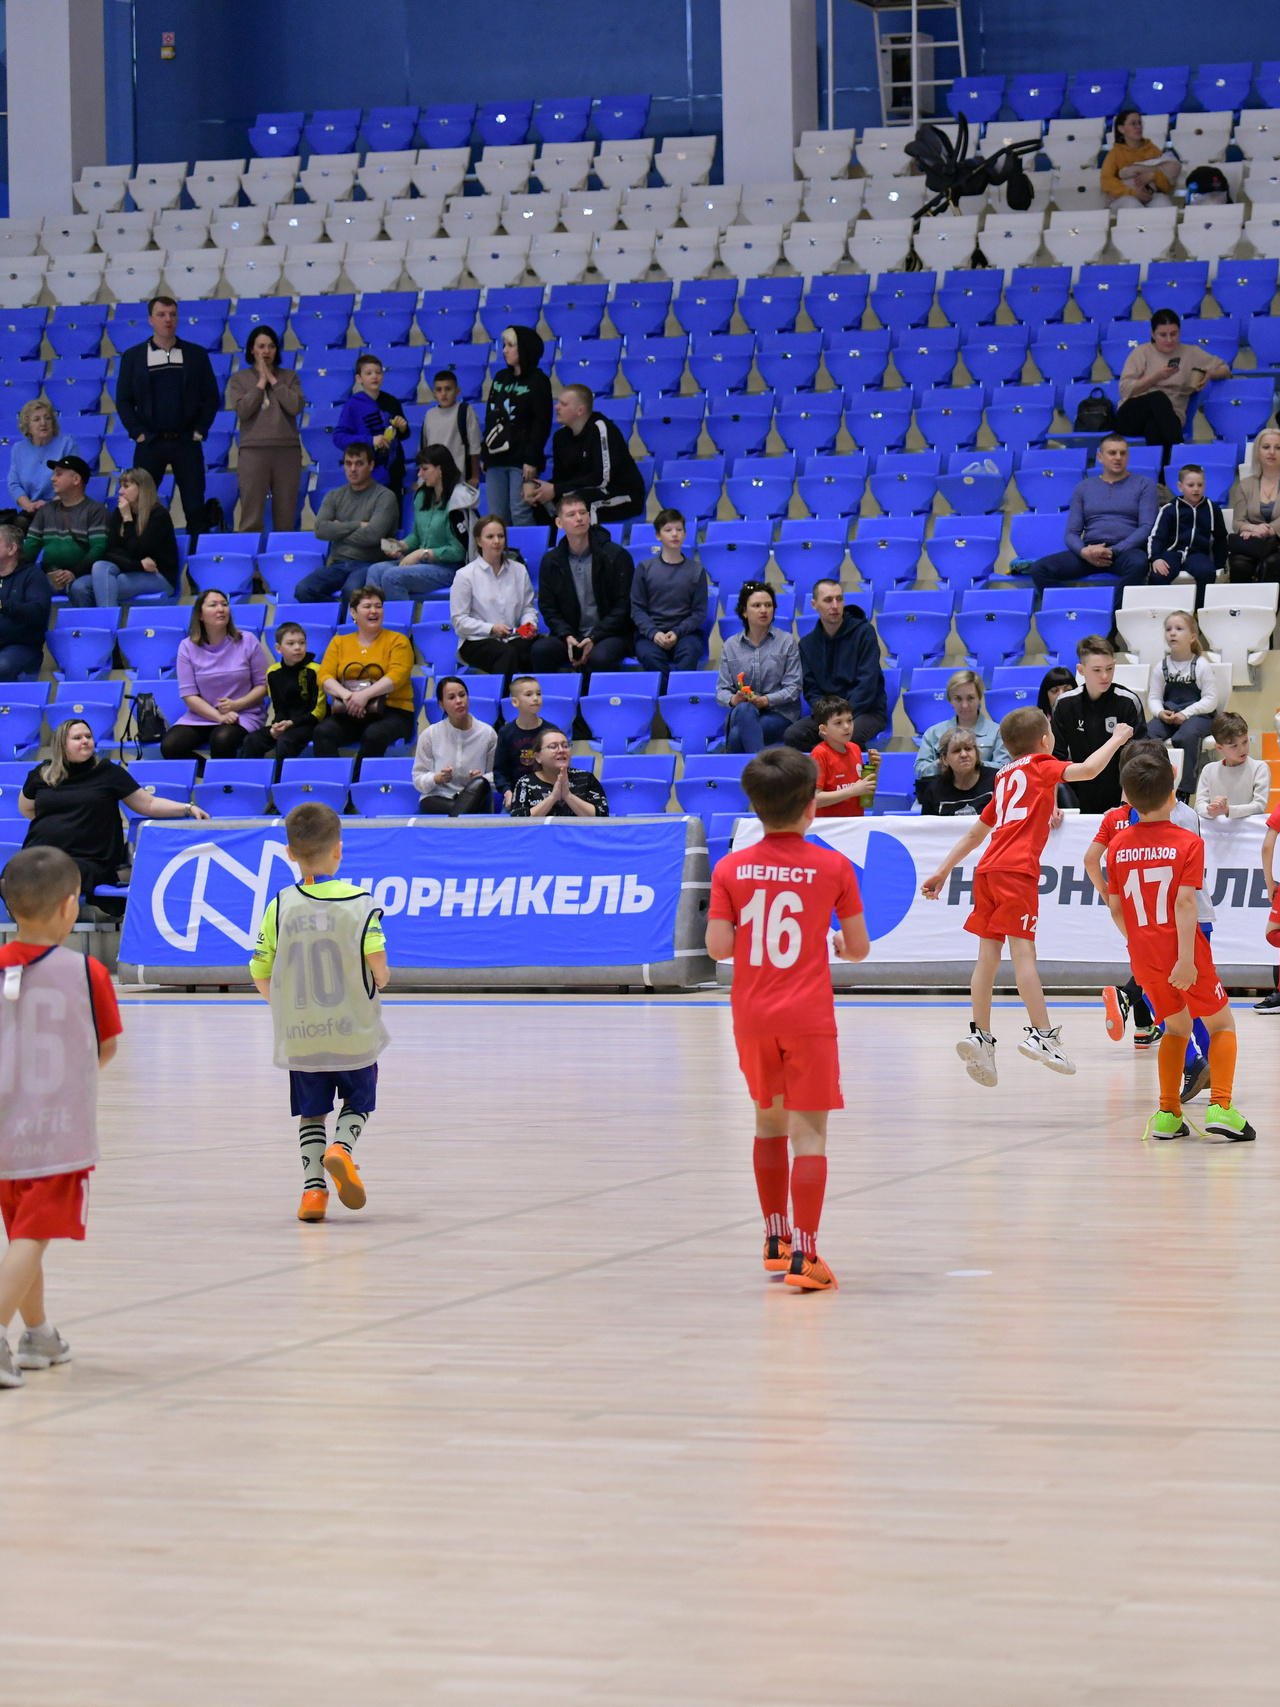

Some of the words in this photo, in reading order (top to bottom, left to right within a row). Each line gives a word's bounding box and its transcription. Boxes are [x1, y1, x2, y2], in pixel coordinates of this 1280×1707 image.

[995, 769, 1028, 827] 12
[736, 864, 817, 884] ШЕЛЕСТ
[1116, 846, 1177, 864] БЕЛОГЛАЗОВ
[1123, 866, 1174, 927] 17
[740, 889, 804, 969] 16
[1020, 913, 1038, 933] 12
[286, 938, 345, 1009] 10
[286, 1018, 334, 1040] unicef
